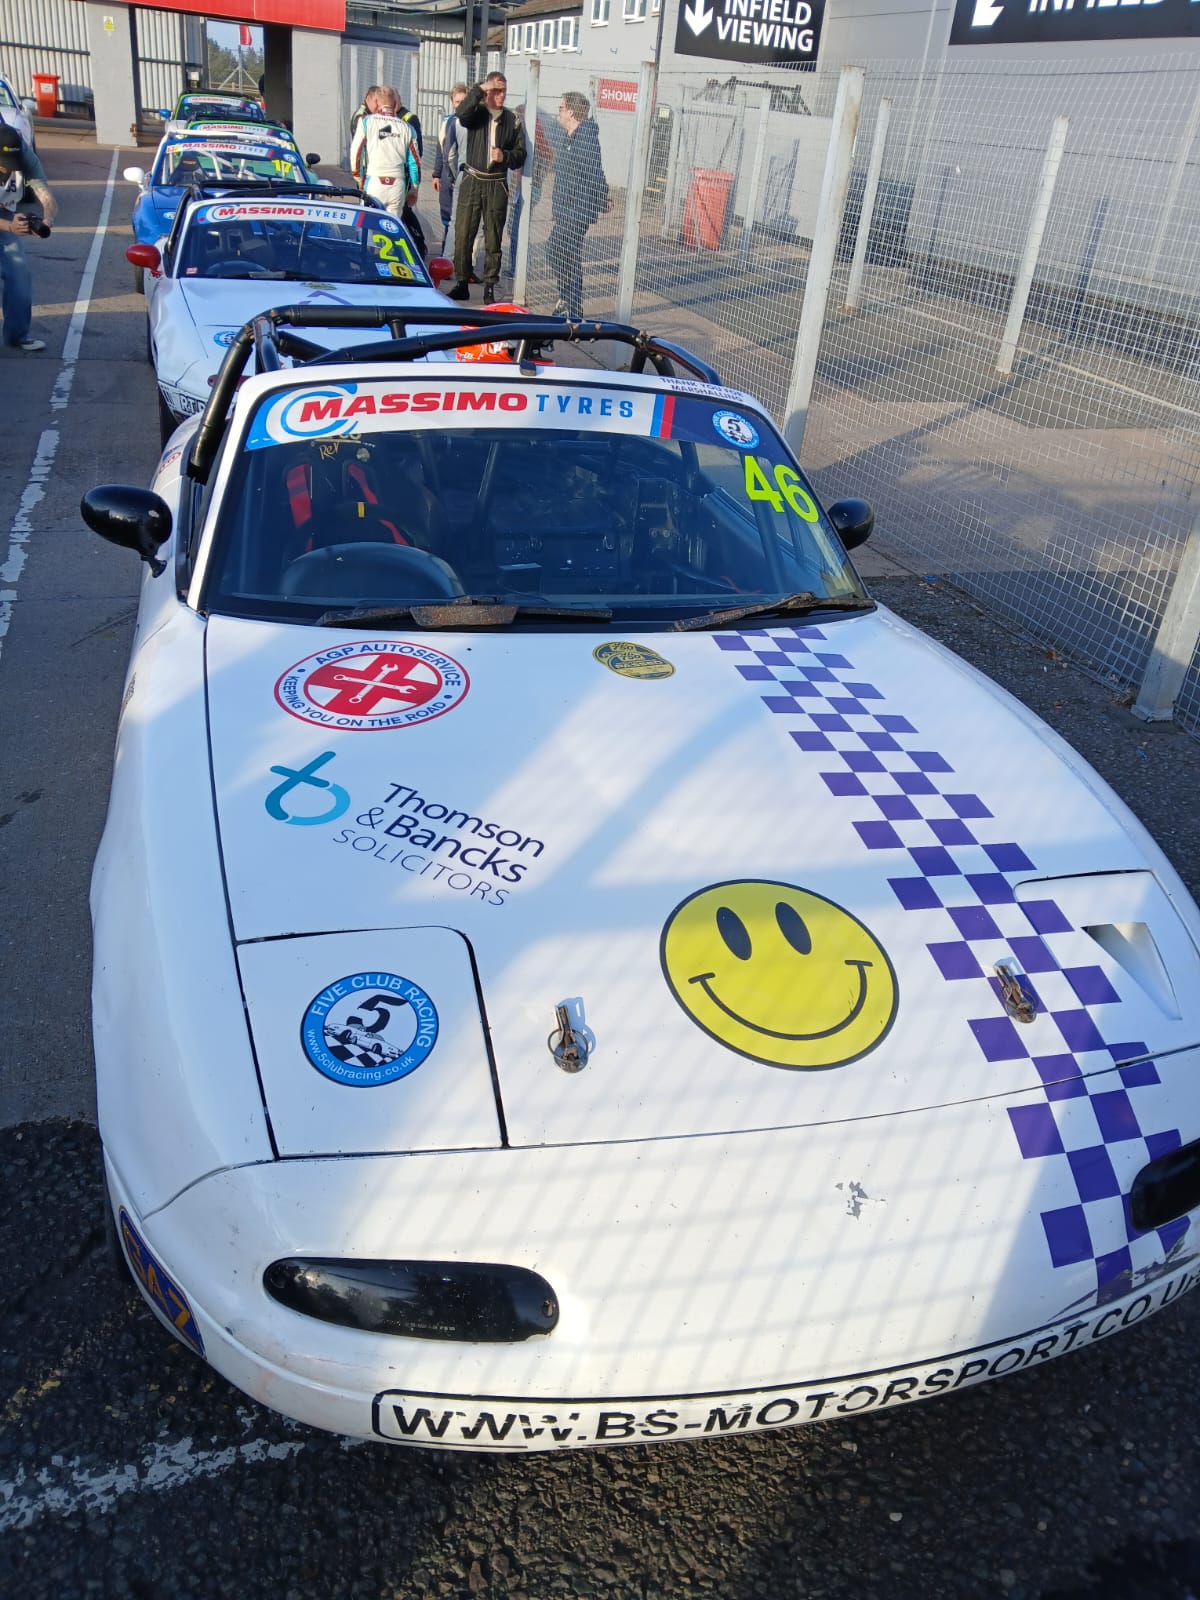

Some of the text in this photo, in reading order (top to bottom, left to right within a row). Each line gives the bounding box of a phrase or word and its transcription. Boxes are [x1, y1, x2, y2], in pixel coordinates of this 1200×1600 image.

[724, 0, 812, 25] INFIELD
[716, 16, 814, 51] VIEWING
[219, 206, 347, 220] MASSIMO TYRES
[372, 234, 416, 266] 21
[661, 377, 698, 387] THANK
[671, 384, 743, 402] MARSHALLING
[299, 392, 633, 422] MASSIMO TYRES
[744, 455, 819, 523] 46
[315, 643, 461, 687] AGP AUTOSERVICE
[282, 675, 447, 728] KEEPING YOU ON THE ROAD
[383, 782, 545, 858] Thomson
[355, 806, 527, 883] & Bancks
[332, 829, 510, 906] SOLICITORS
[311, 975, 435, 1048] FIVE CLUB RACING
[357, 994, 410, 1033] 5
[306, 1028, 415, 1081] www.5clubracing.co.uk
